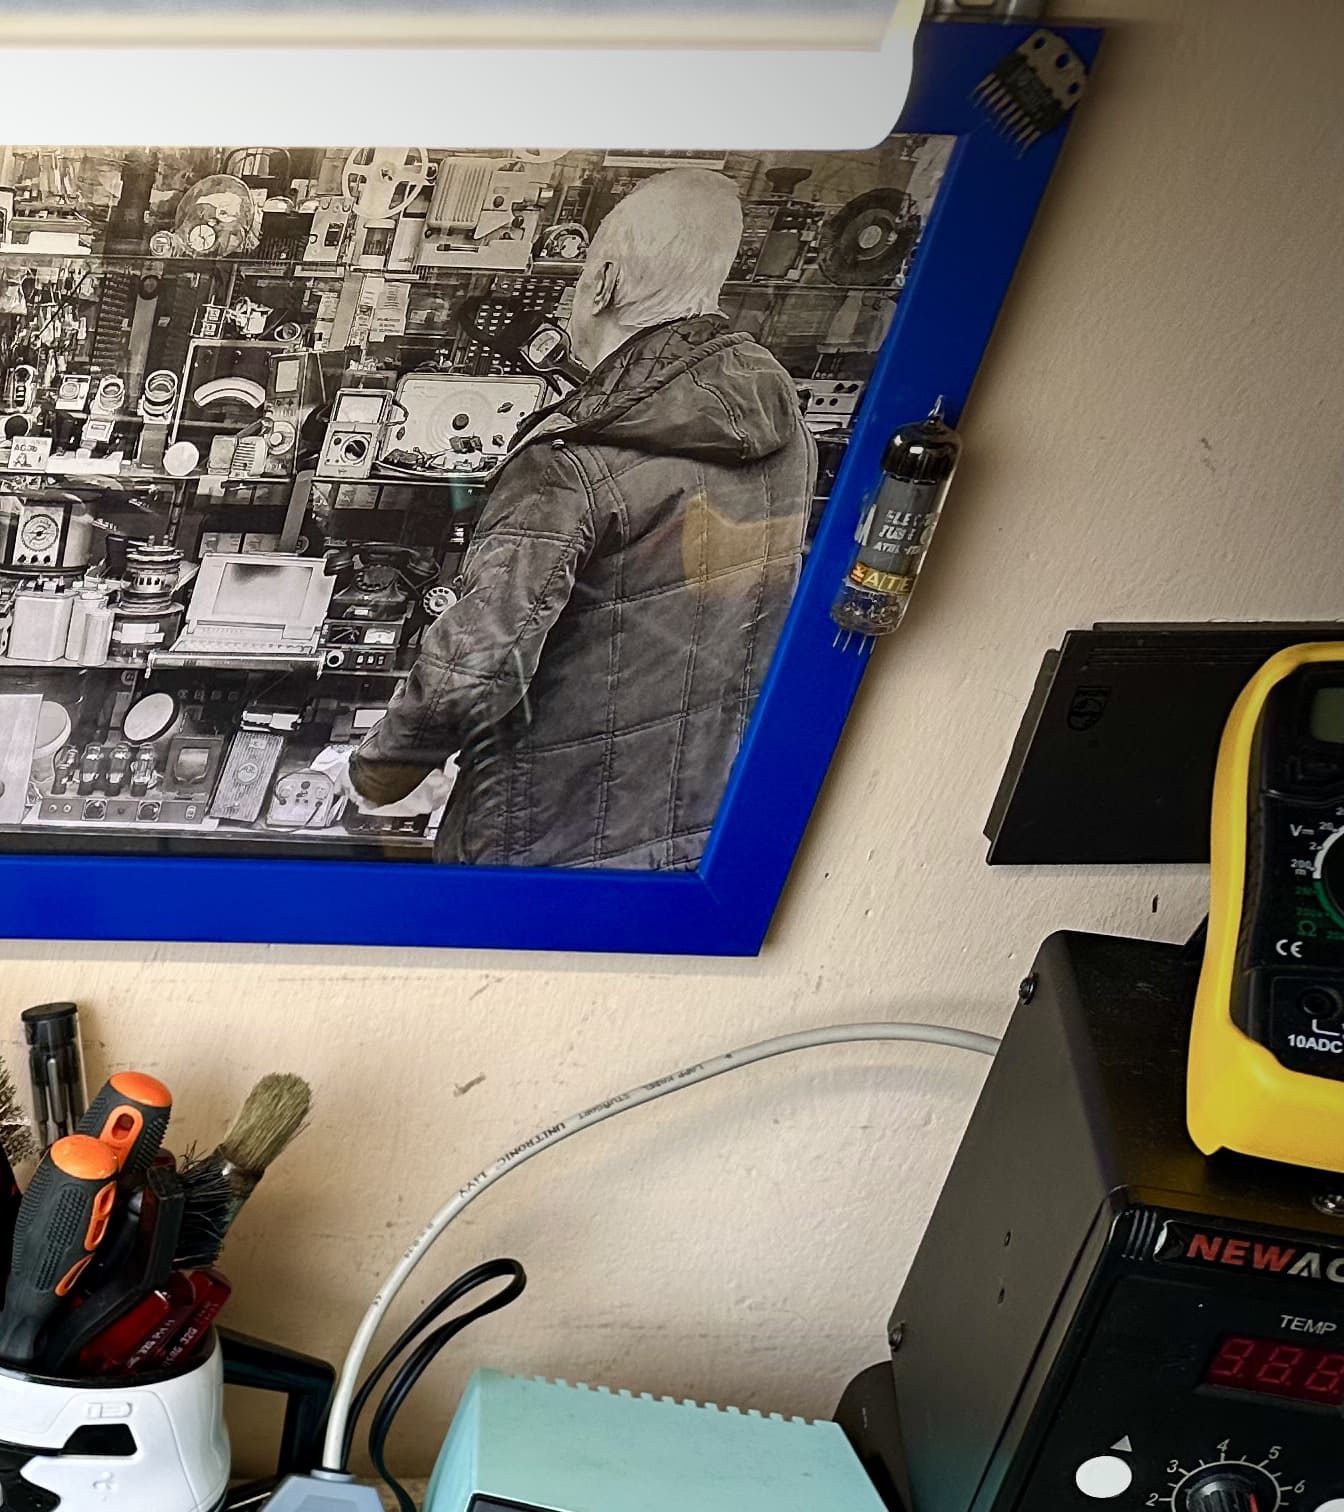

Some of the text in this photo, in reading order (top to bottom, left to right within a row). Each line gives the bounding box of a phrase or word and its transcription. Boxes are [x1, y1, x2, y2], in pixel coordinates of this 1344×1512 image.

[1279, 1314, 1338, 1336] TEMP
[1216, 1439, 1231, 1452] 4
[1268, 1445, 1282, 1460] 5
[1166, 1459, 1179, 1473] 3
[1294, 1480, 1307, 1494] 6
[1145, 1493, 1159, 1507] 2
